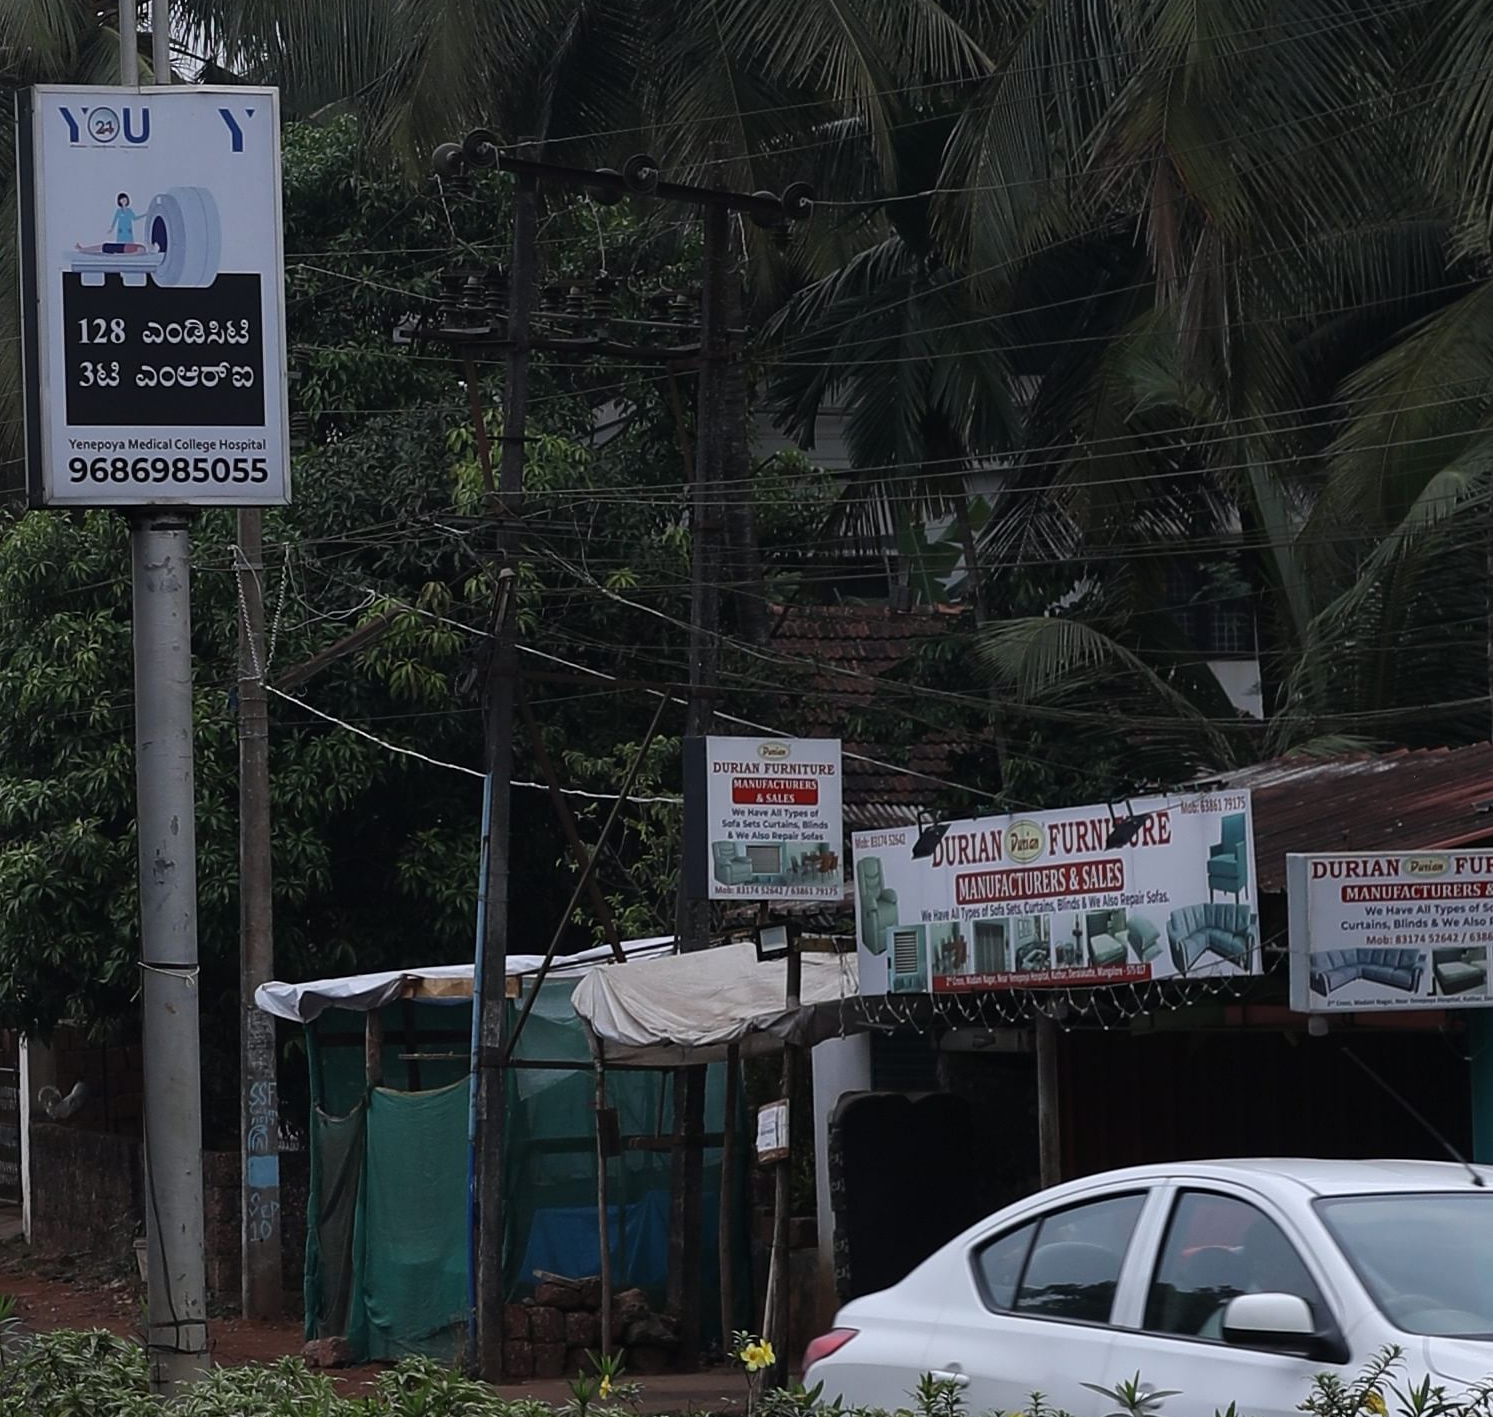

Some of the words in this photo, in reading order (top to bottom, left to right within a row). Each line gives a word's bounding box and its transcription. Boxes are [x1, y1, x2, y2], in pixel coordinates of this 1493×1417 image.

[78, 318, 126, 344] 128
[79, 361, 120, 387] 3ಟಿ
[69, 439, 125, 452] Yenepoya
[128, 439, 172, 450] Medical
[175, 439, 216, 453] College
[219, 439, 266, 452] Hospital
[68, 457, 268, 483] 9686985055
[713, 762, 759, 774] DURIAN
[764, 763, 835, 775] FURNITURE
[734, 779, 817, 790] MANUFACTURERS
[756, 793, 763, 803] &
[766, 793, 795, 803] SALES
[731, 808, 745, 816] We
[747, 808, 768, 816] Have
[770, 808, 782, 816] All
[784, 809, 808, 819] Types
[810, 809, 819, 817] of
[722, 819, 741, 828] Sofa
[743, 820, 760, 828] Sets
[763, 820, 800, 829] Curtains,
[802, 820, 828, 829] Blinds
[772, 831, 798, 841] Repair
[801, 832, 823, 840] Sofas
[932, 830, 1003, 868] DURIAN
[1312, 859, 1401, 879] DURIAN
[959, 868, 1065, 901] MANUFACTURERS
[1070, 873, 1079, 890] &
[1083, 862, 1122, 889] SALES
[715, 886, 734, 894] Mob:
[1347, 884, 1481, 900] MANUFACTURERS
[921, 910, 932, 922] We
[934, 910, 950, 920] Have
[951, 908, 959, 920] All
[961, 906, 980, 922] Types
[982, 906, 988, 917] of
[990, 905, 1005, 917] Sofa
[1024, 900, 1056, 915] Curtains,
[1057, 898, 1080, 911] Blinds
[1082, 899, 1087, 909] &
[1089, 897, 1100, 908] We
[1102, 896, 1118, 906] Also
[1120, 893, 1145, 907] Repair
[1146, 891, 1169, 904] Sofas.
[1365, 906, 1383, 916] We
[1386, 906, 1413, 916] Have
[1416, 904, 1430, 914] All
[1434, 904, 1465, 917] Types
[1468, 903, 1479, 913] of
[1341, 920, 1391, 931] Curtains,
[1393, 919, 1428, 929] Blinds
[1431, 919, 1438, 928] &
[1442, 918, 1460, 927] We
[1463, 916, 1486, 926] Also
[1366, 935, 1393, 945] Mob:
[1395, 934, 1425, 944] 83174
[1428, 933, 1458, 943] 52642
